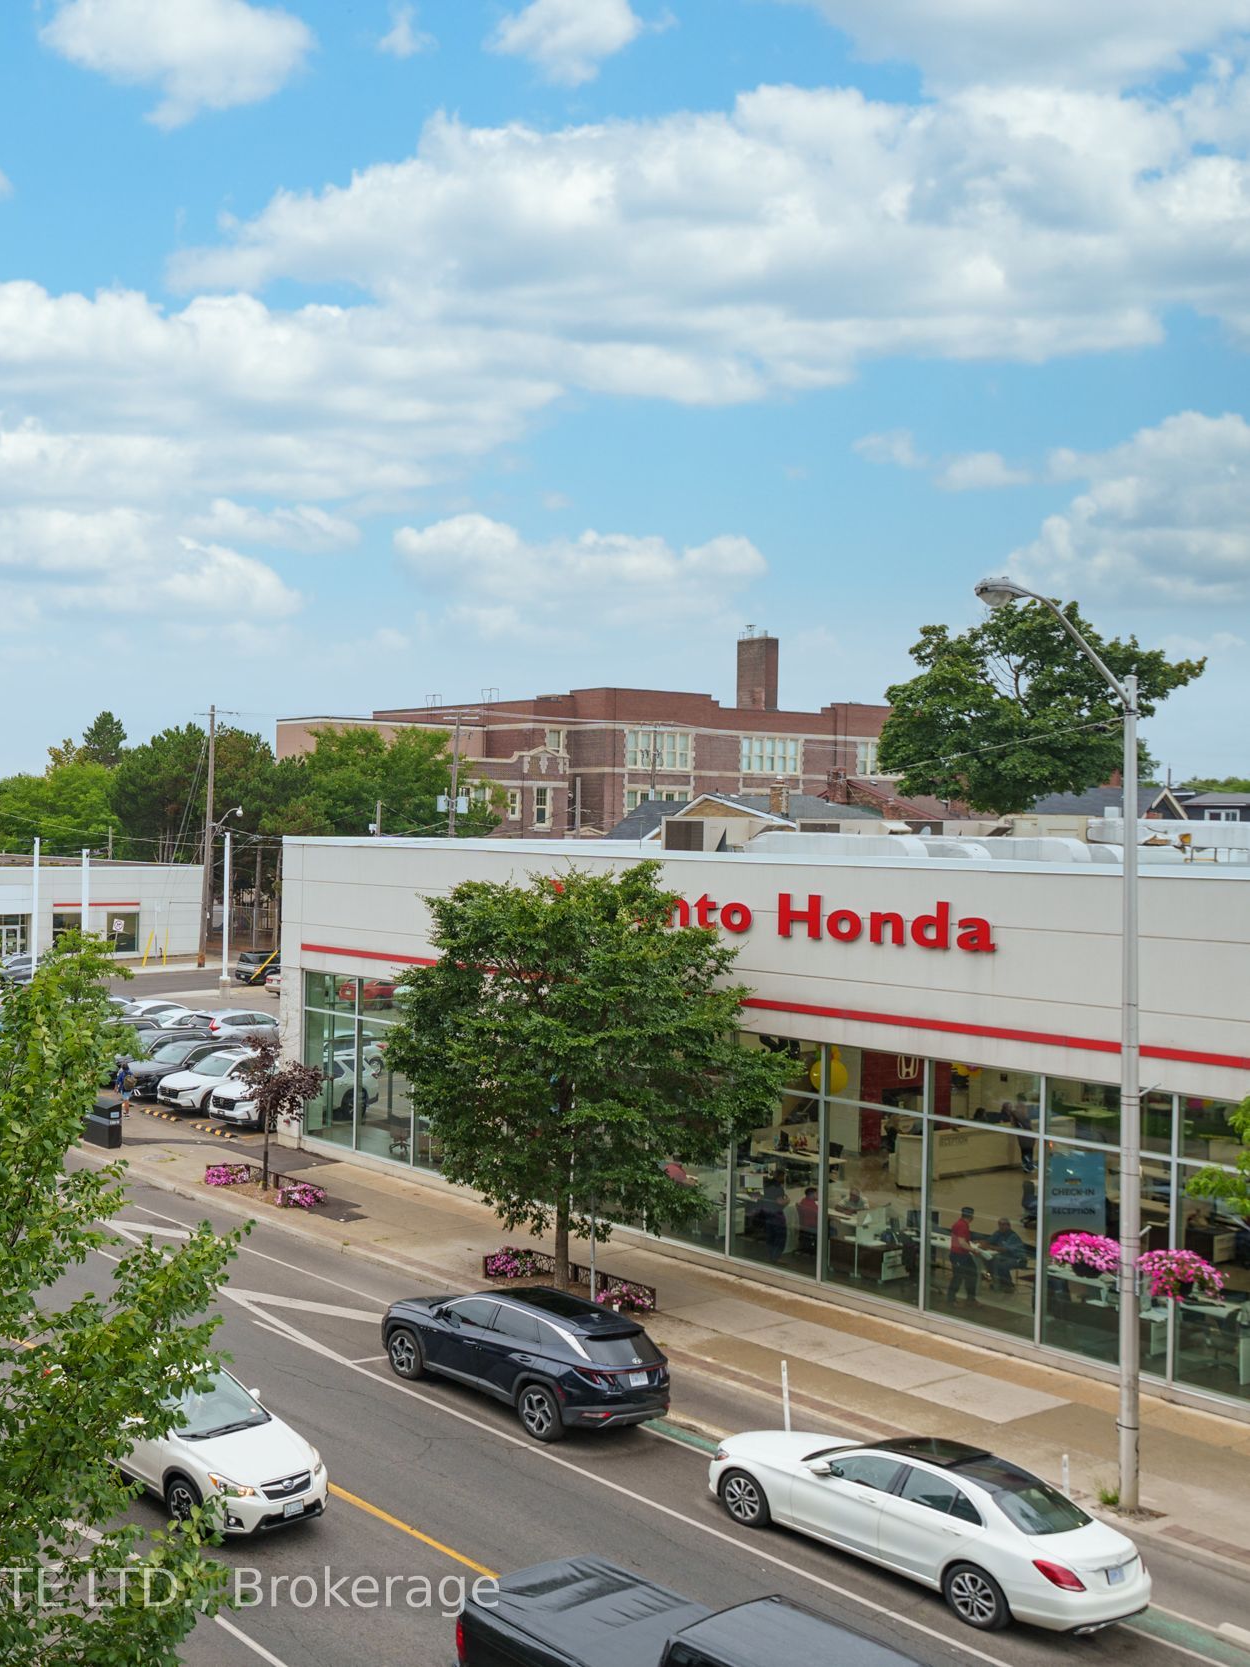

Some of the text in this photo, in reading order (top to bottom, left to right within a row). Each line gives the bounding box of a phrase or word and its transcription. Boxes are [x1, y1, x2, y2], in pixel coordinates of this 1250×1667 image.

[777, 893, 997, 952] Honda
[1051, 1188, 1096, 1196] CHECK-IN
[1051, 1207, 1096, 1215] RECEPTION
